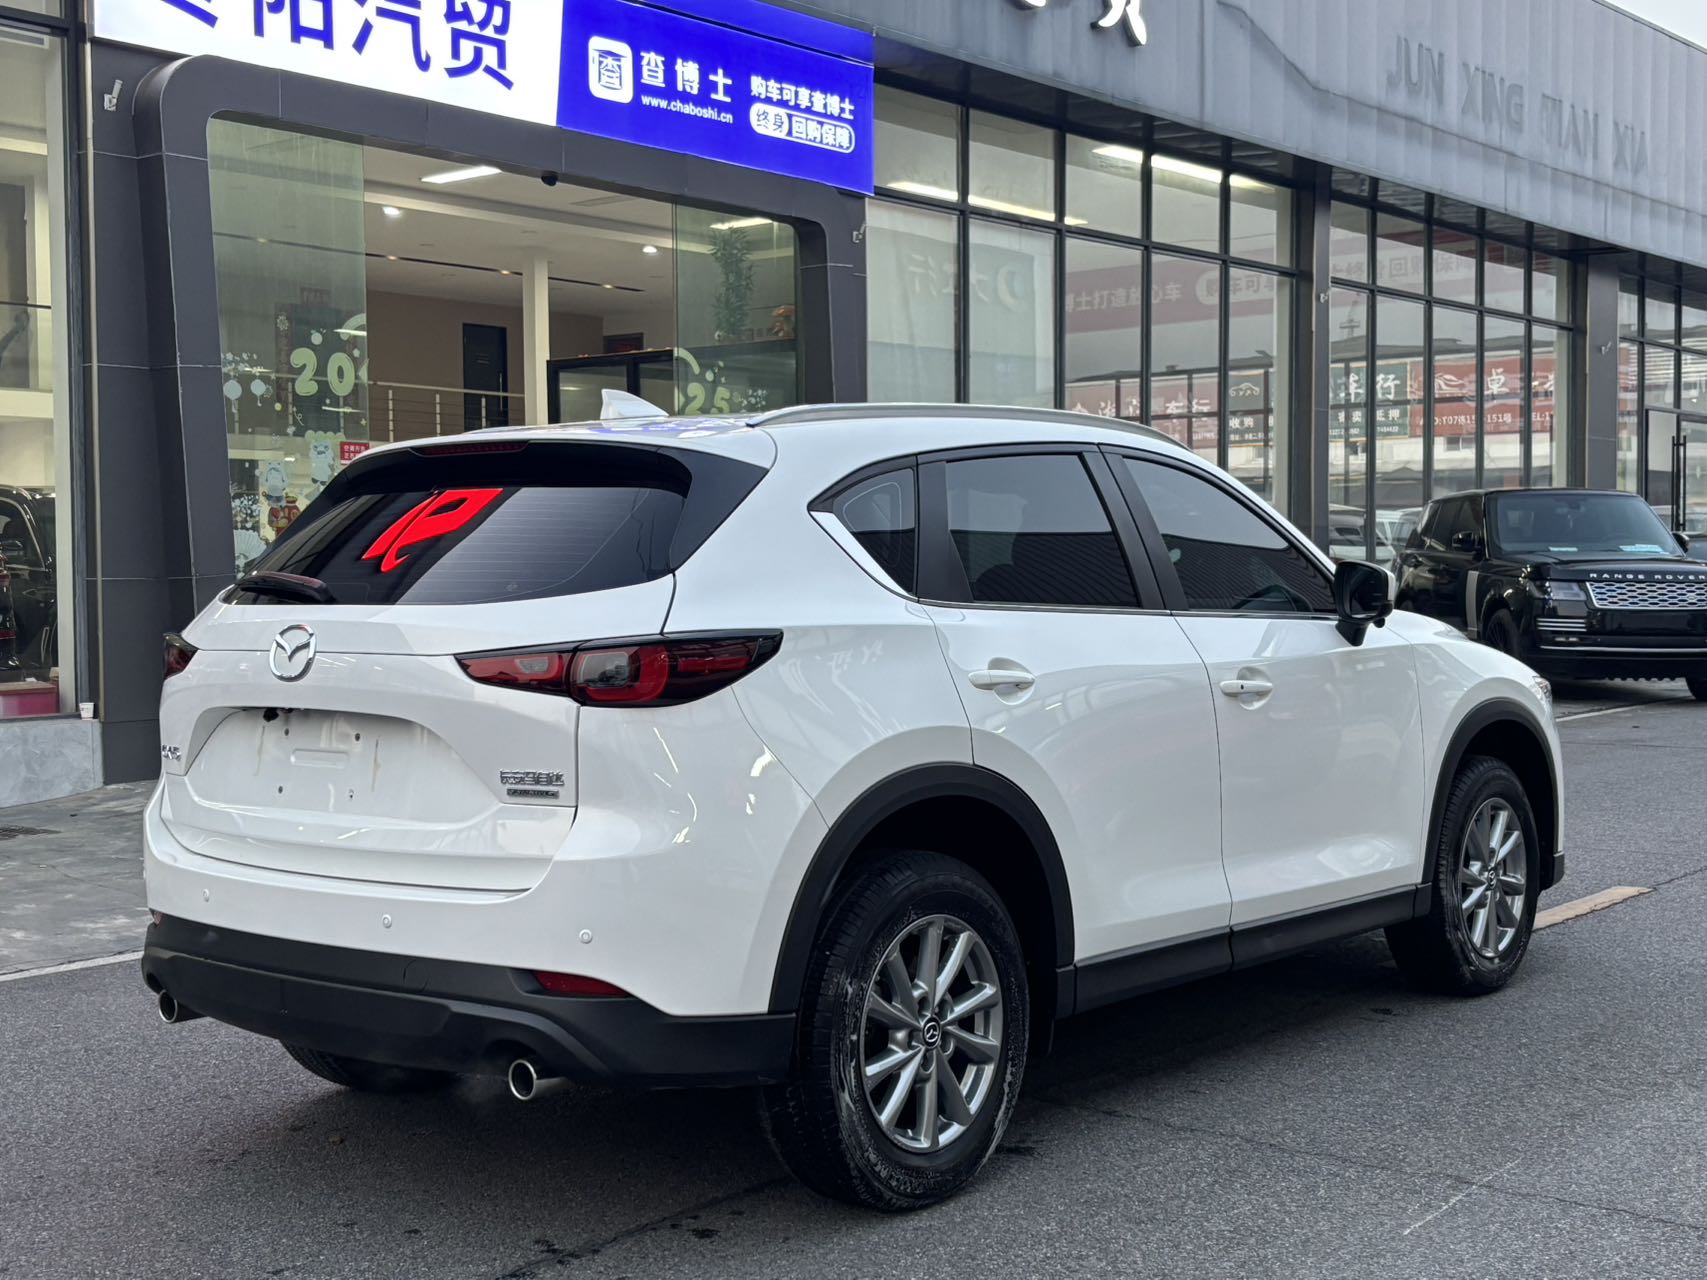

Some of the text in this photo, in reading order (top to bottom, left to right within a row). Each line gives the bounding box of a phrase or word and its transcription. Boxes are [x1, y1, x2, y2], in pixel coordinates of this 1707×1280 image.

[640, 51, 733, 103] 查博士
[1386, 34, 1445, 111] JUN
[641, 93, 733, 124] www.chaboshi.cn
[750, 75, 855, 121] 购车可享查博士
